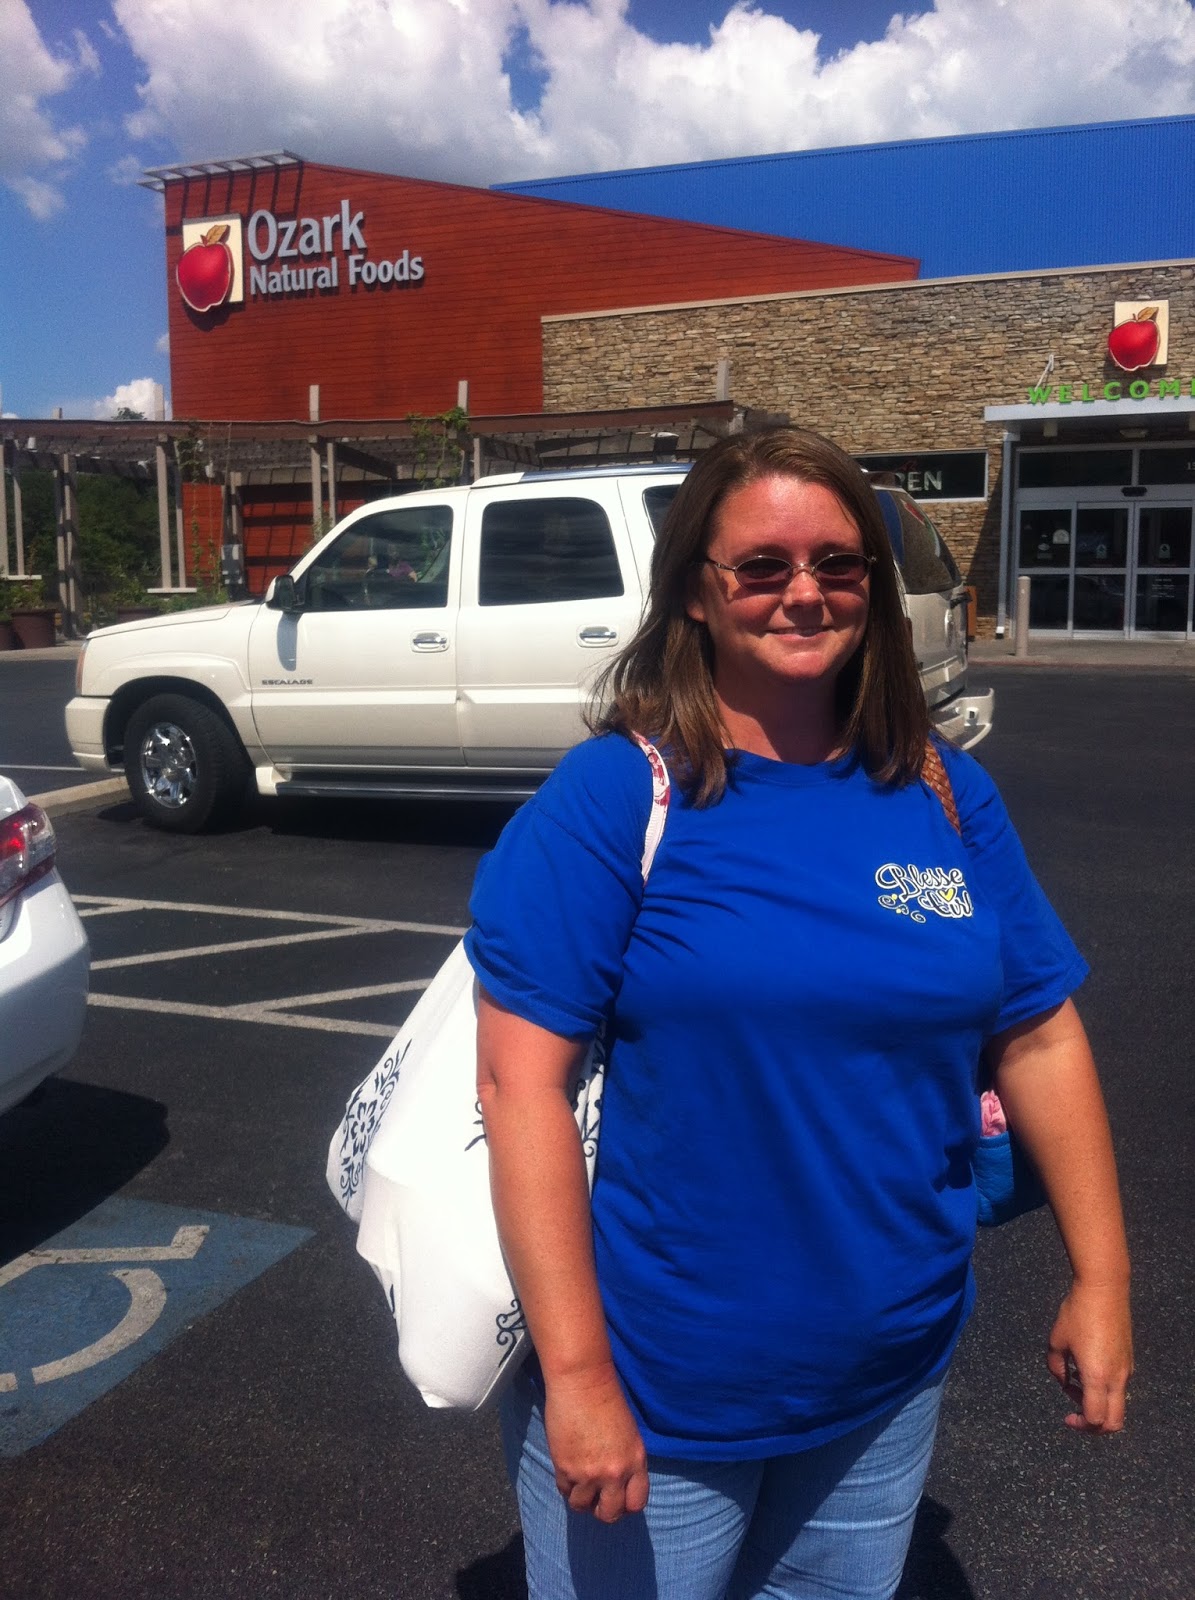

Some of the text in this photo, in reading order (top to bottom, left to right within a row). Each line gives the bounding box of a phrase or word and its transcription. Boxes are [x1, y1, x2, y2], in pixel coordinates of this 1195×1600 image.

[247, 199, 367, 261] Ozark
[250, 249, 425, 296] Natural Foods
[895, 470, 942, 491] EN
[261, 678, 313, 686] ESCALADE
